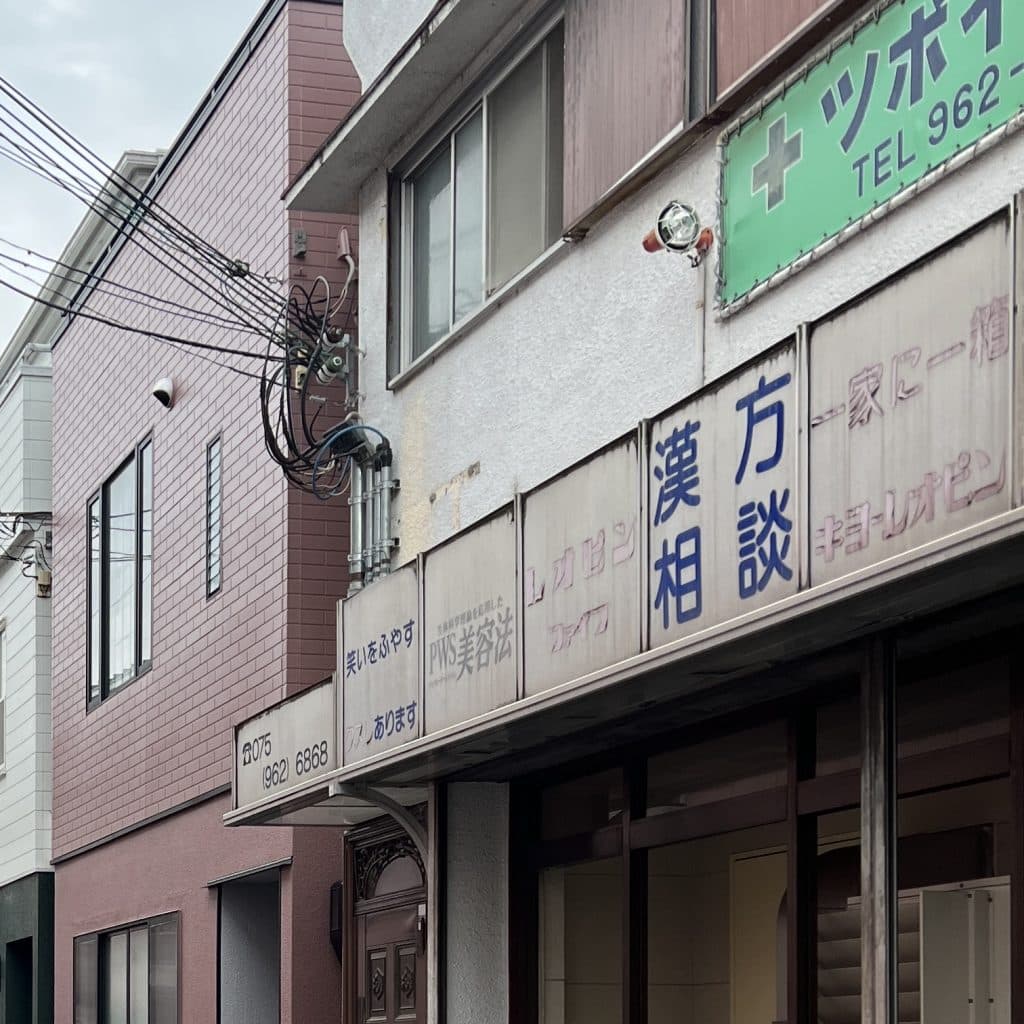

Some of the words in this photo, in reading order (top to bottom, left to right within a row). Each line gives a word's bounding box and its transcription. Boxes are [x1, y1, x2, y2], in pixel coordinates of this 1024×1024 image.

[852, 128, 917, 198] TEL
[346, 618, 416, 678] 笑いをふやす
[262, 756, 289, 790] (962)
[296, 740, 328, 776] 6868
